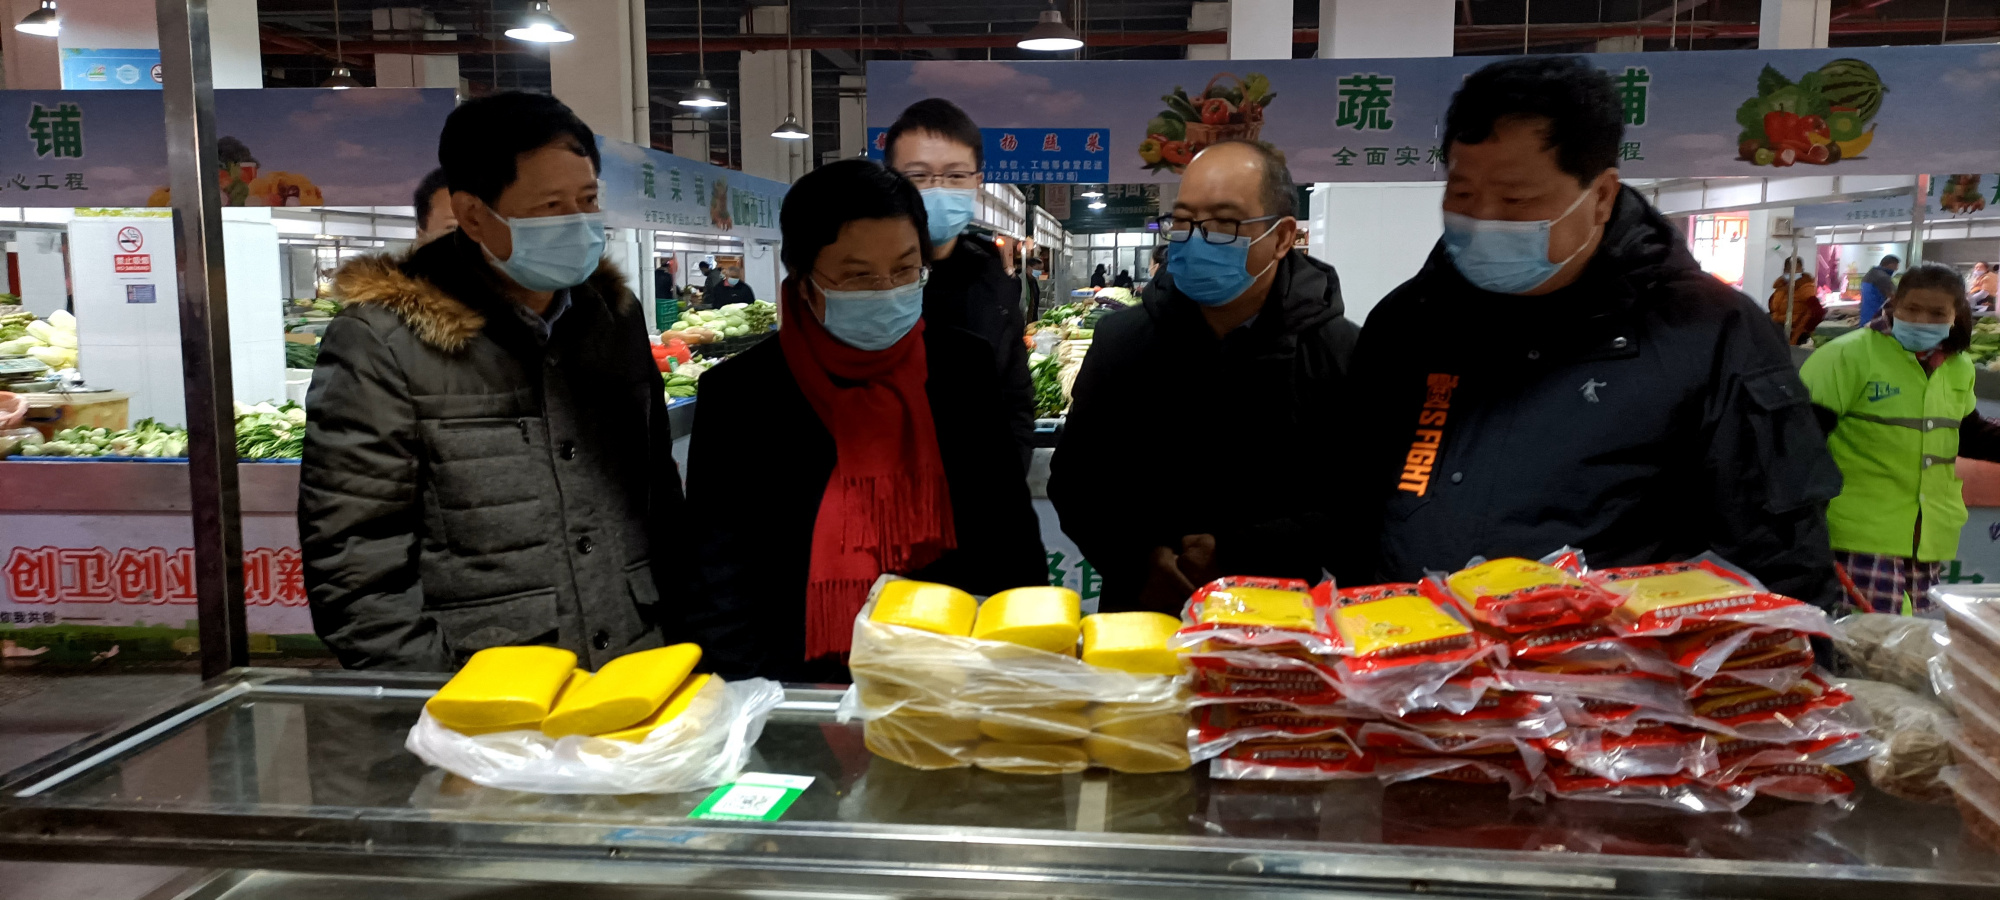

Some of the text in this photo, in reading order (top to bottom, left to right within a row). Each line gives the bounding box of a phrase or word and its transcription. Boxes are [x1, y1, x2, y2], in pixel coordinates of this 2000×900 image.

[28, 103, 84, 158] 铺
[1335, 74, 1395, 131] 蔬
[1397, 429, 1443, 498] FIGHT
